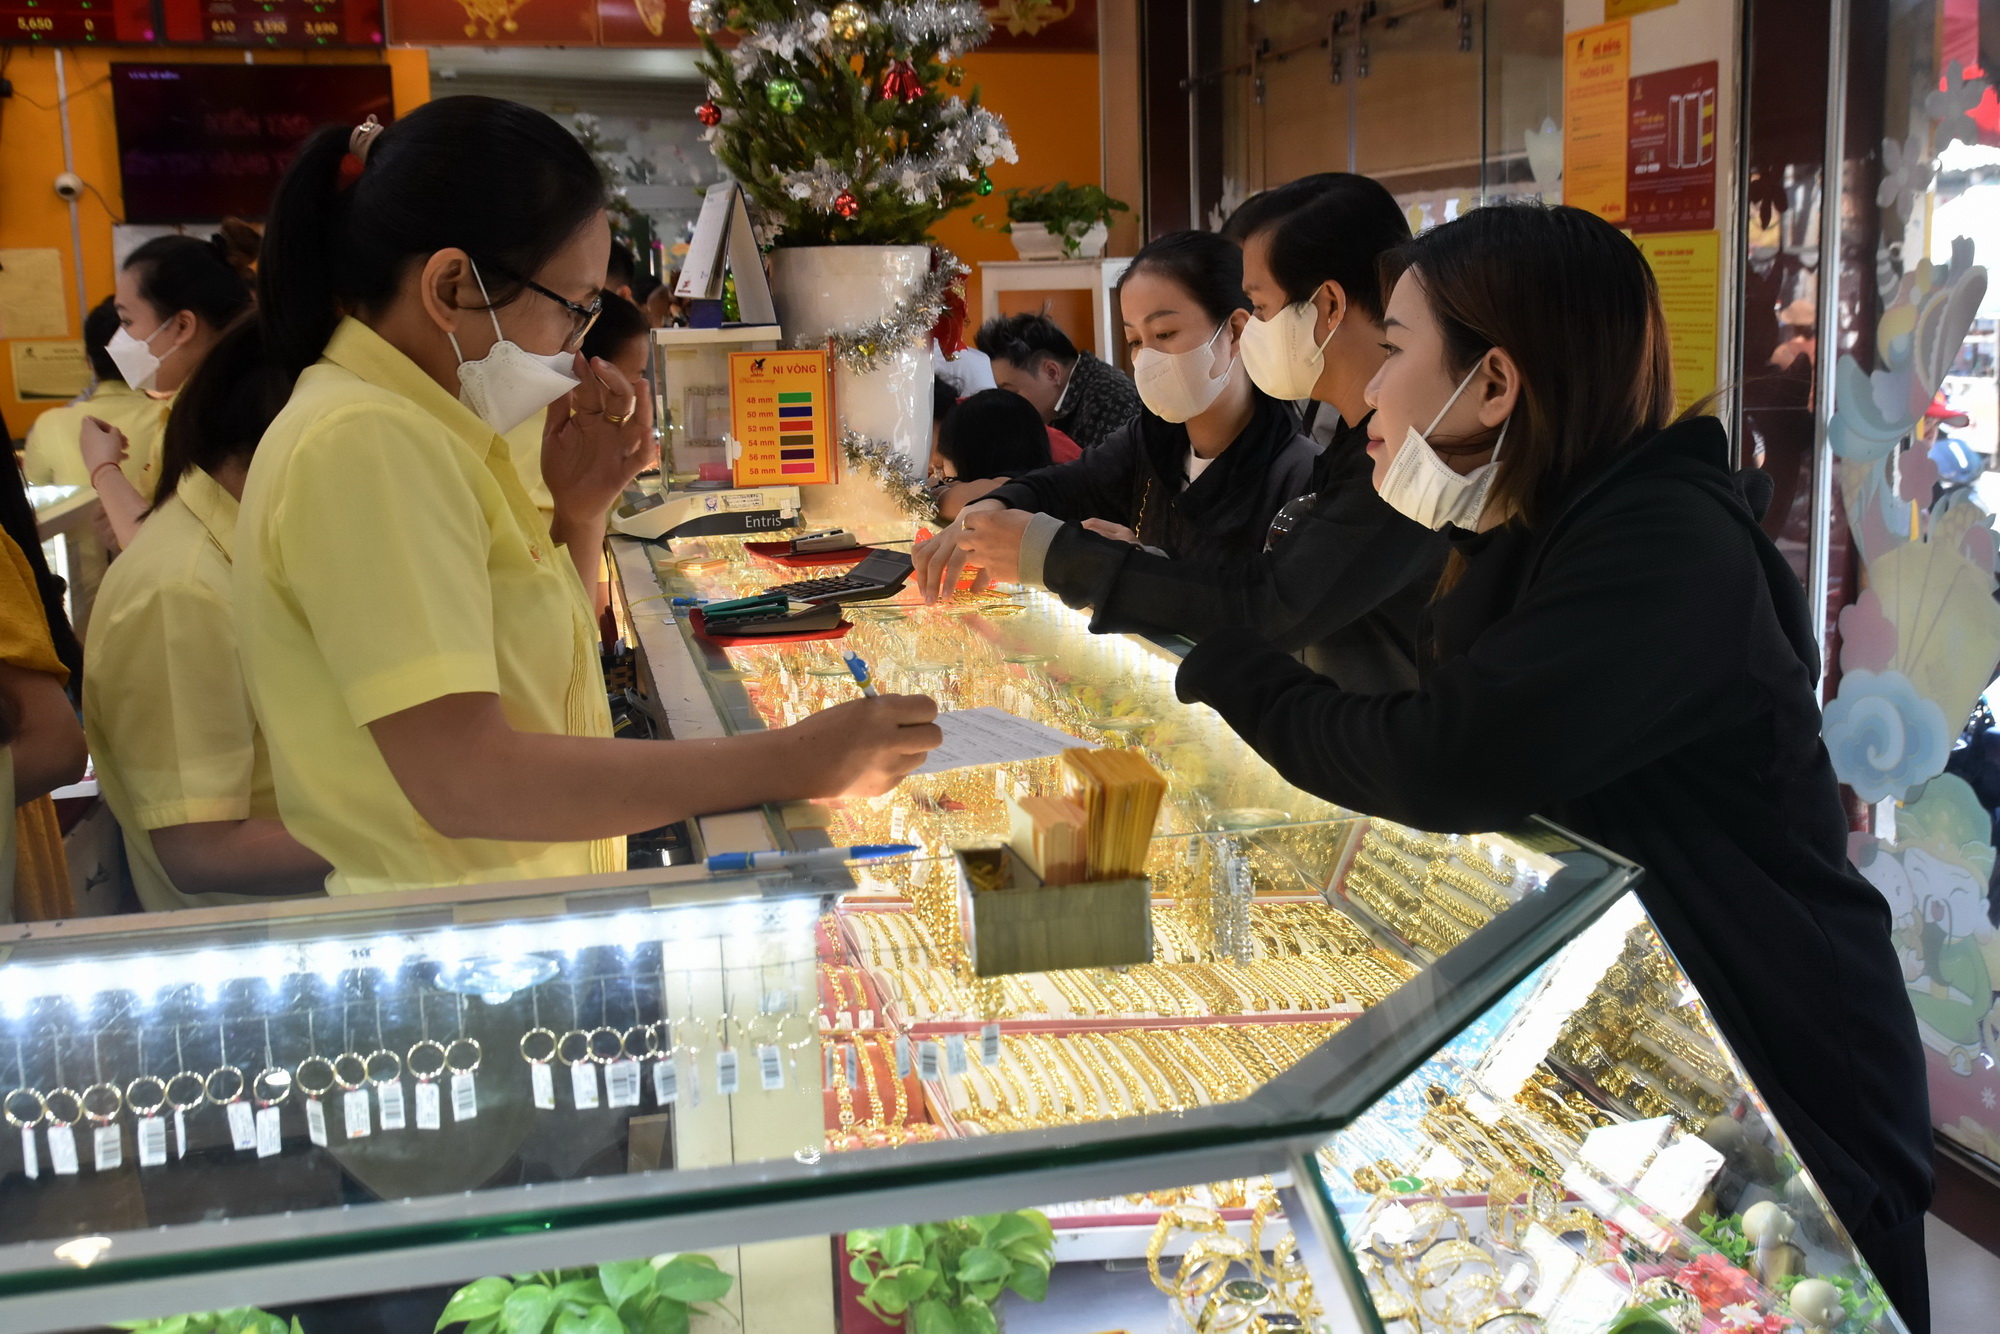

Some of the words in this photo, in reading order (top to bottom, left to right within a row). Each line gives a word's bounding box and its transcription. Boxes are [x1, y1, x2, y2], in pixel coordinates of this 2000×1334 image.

[772, 365, 784, 374] NI
[788, 363, 817, 374] VÒNG
[746, 396, 756, 404] 48
[748, 439, 758, 447] 54
[749, 453, 759, 461] 56
[749, 467, 759, 475] 58
[745, 514, 782, 528] Entris
